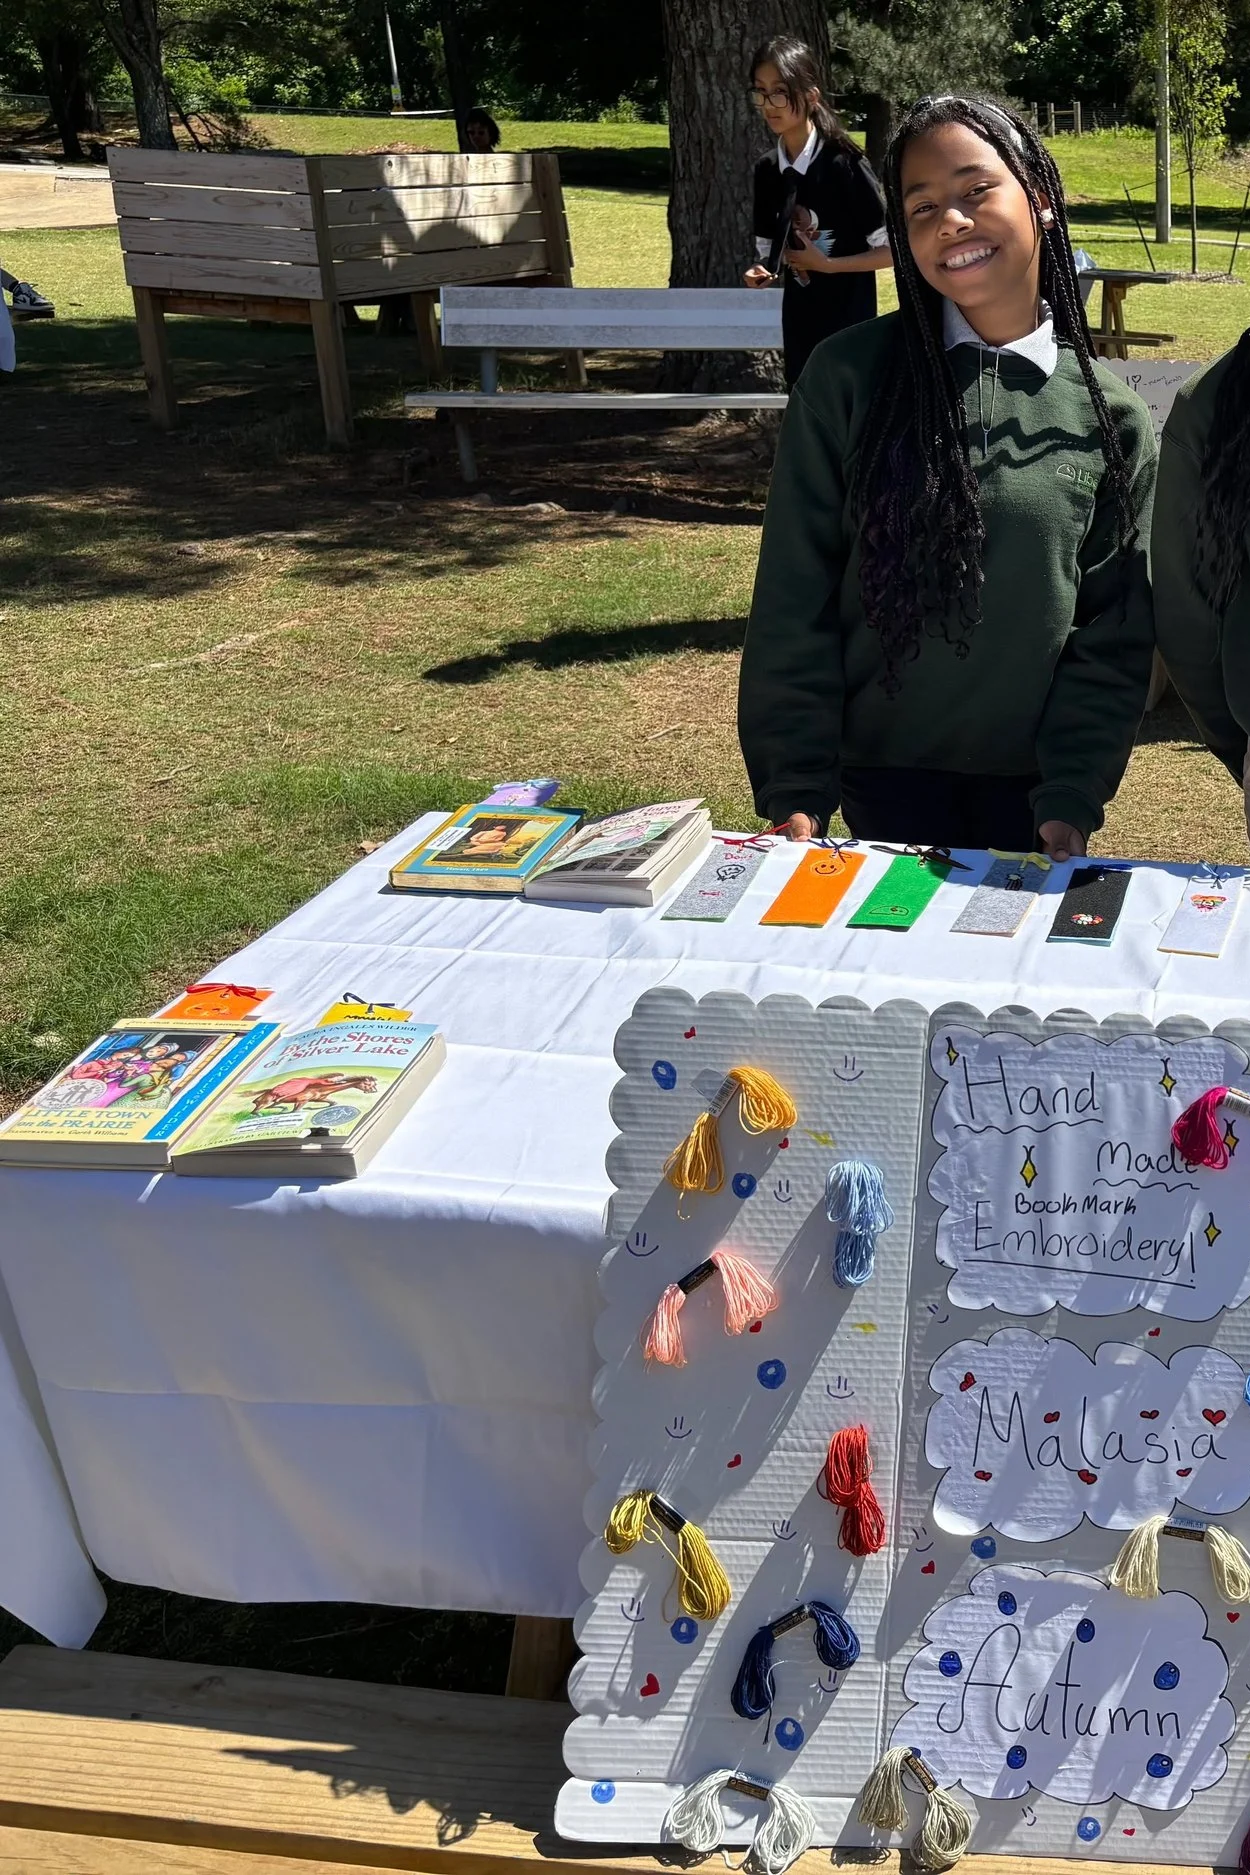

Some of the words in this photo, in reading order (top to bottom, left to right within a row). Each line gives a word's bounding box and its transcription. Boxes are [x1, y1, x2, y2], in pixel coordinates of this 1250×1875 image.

[263, 1055, 285, 1069] of
[287, 1044, 350, 1062] Silver
[351, 1042, 409, 1056] Lake
[306, 1034, 339, 1049] the
[343, 1032, 415, 1045] Shores
[962, 1055, 1100, 1120] Hand
[25, 1109, 92, 1118] LITTLE
[96, 1110, 154, 1119] TOWN
[60, 1120, 136, 1129] PRAIRIE
[1096, 1141, 1200, 1175] Made
[974, 1199, 1196, 1284] Embroidery!
[972, 1386, 1227, 1471] Malasia
[936, 1623, 1182, 1739] Autumn
